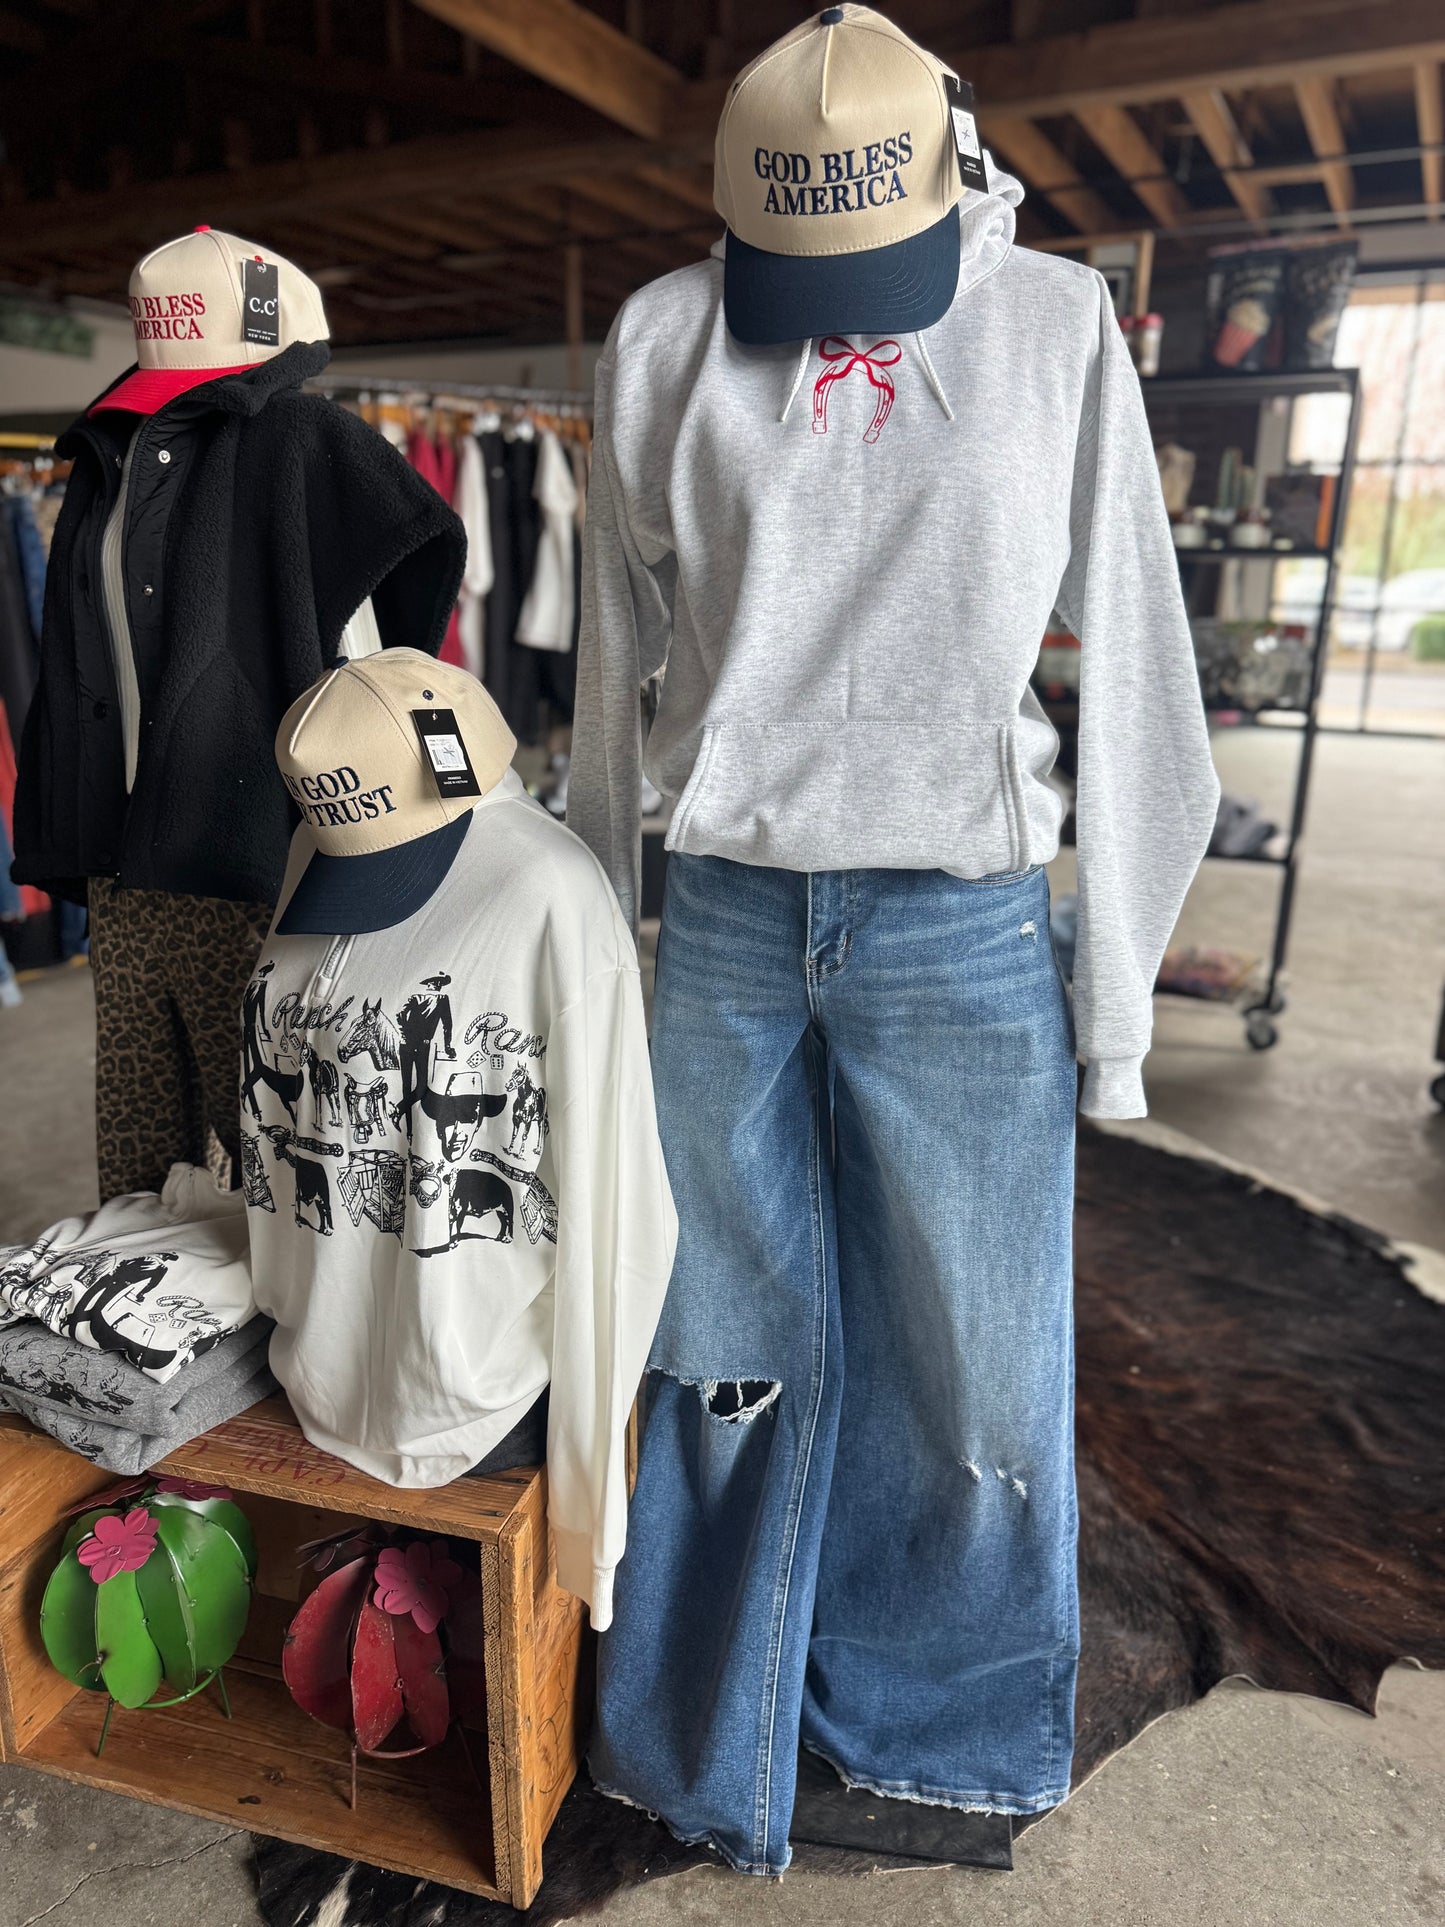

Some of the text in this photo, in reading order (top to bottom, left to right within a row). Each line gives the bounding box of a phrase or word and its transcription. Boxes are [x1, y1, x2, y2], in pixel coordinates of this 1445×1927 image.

[754, 131, 913, 184] GOD BLESS
[764, 170, 908, 216] AMERICA
[141, 292, 206, 318] BLESS
[134, 318, 204, 340] MERICA
[300, 766, 361, 800] GOD
[307, 785, 397, 827] TRUST
